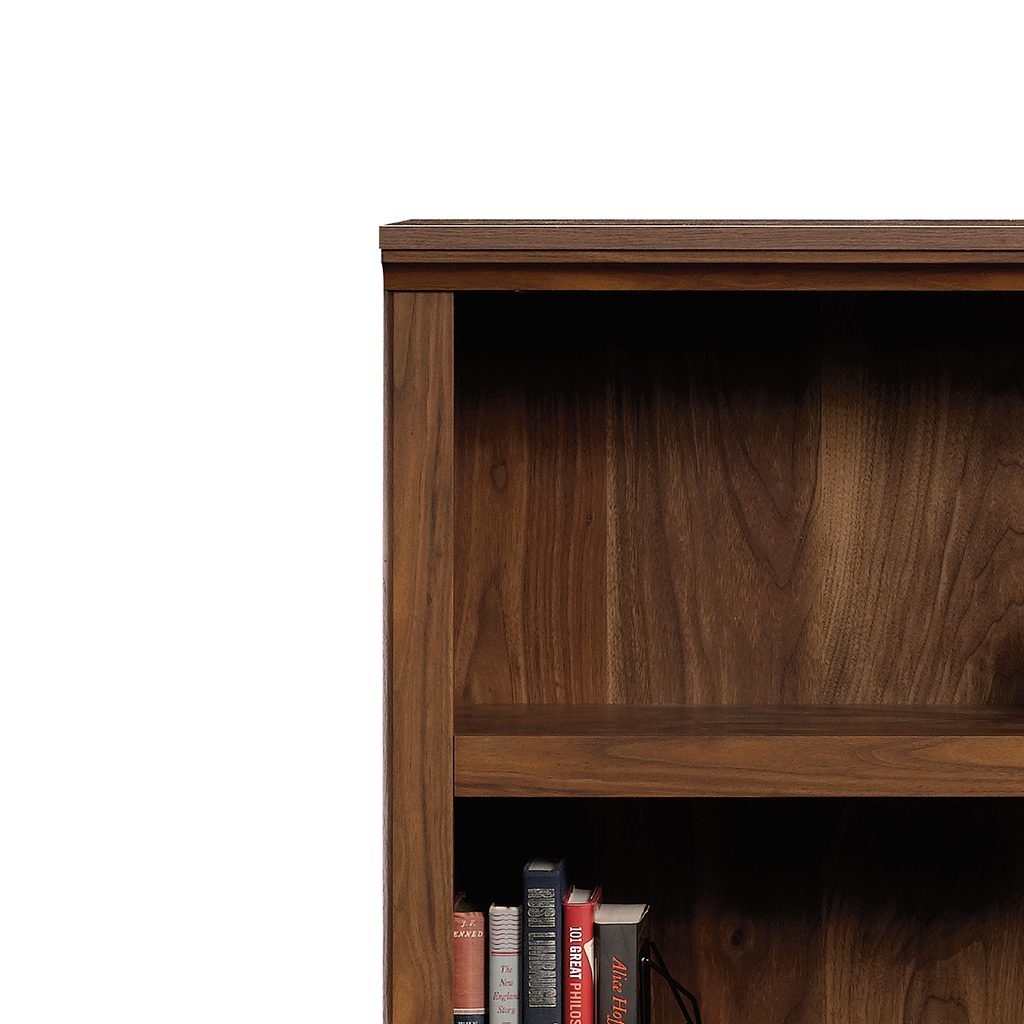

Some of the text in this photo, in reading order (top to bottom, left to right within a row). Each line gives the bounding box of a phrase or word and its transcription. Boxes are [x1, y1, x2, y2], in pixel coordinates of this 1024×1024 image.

[569, 926, 583, 942] 101
[527, 888, 557, 1008] RUSH LIMBAUGH
[569, 945, 583, 980] GREAT
[499, 965, 513, 974] The
[612, 956, 628, 994] Alice
[498, 978, 513, 987] New
[492, 991, 520, 1002] England
[496, 1005, 517, 1015] Story
